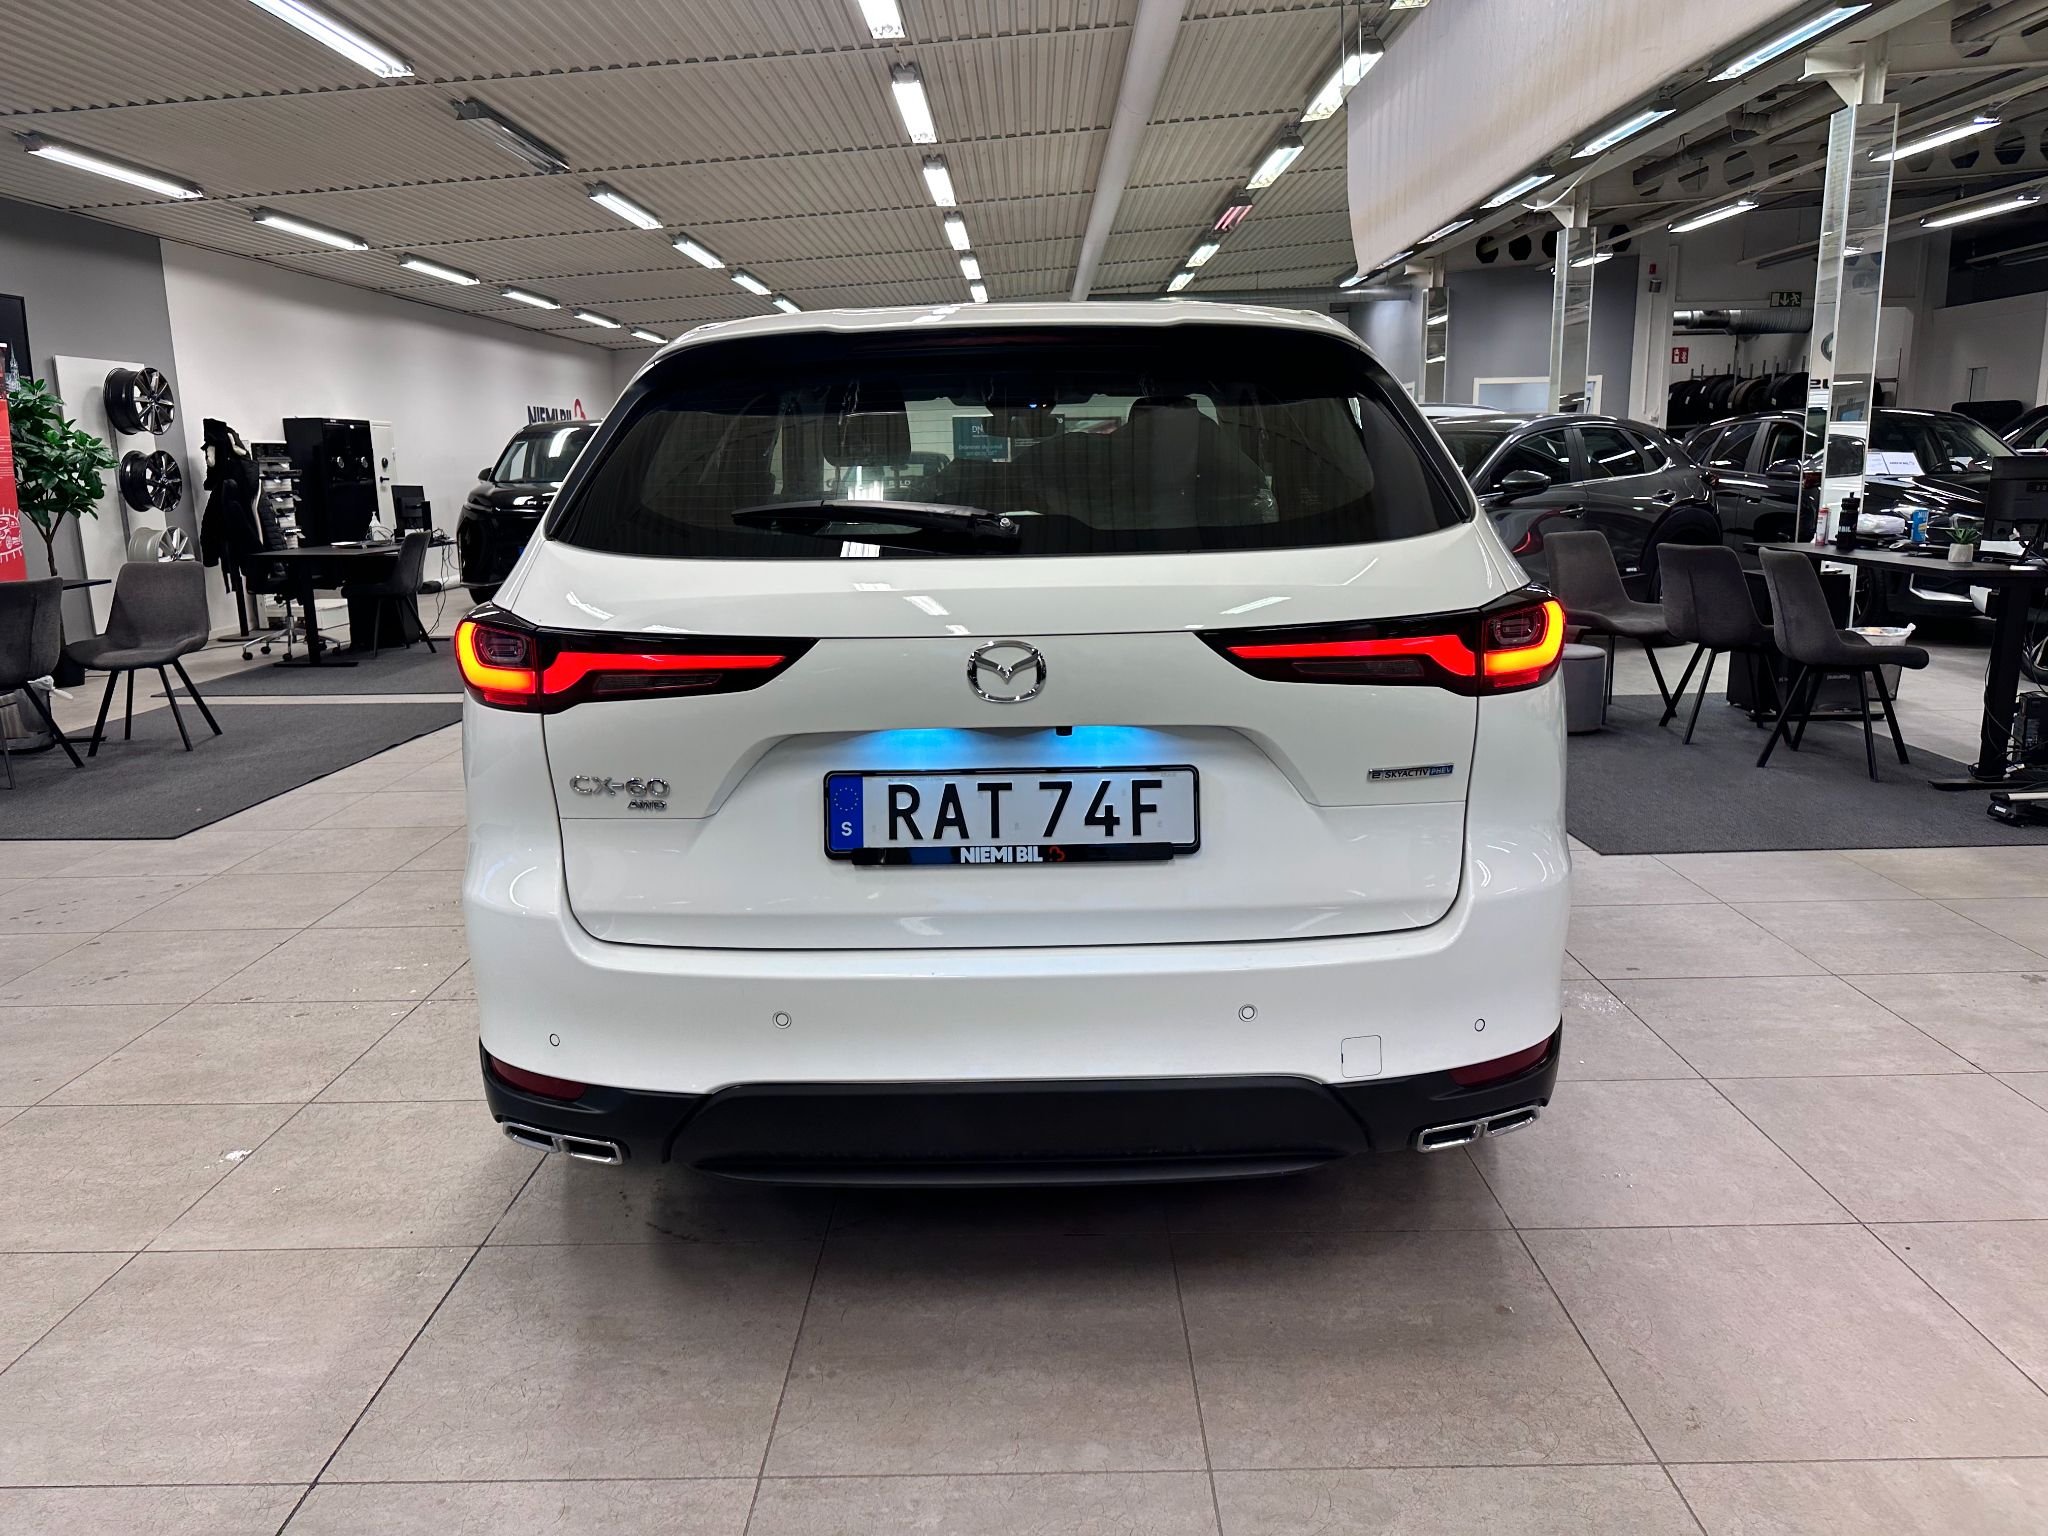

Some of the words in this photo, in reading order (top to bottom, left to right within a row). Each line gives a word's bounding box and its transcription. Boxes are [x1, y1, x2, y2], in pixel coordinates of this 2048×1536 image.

[527, 405, 558, 425] NIEMI
[1384, 768, 1429, 779] SKYACTIV
[1430, 765, 1452, 775] PHEV
[569, 776, 671, 798] CX-60
[627, 800, 668, 811] AWD
[887, 781, 1013, 841] RAT
[1038, 779, 1163, 839] 74F
[840, 821, 853, 837] S
[960, 846, 1013, 864] NIEMI
[1016, 846, 1043, 863] BIL
